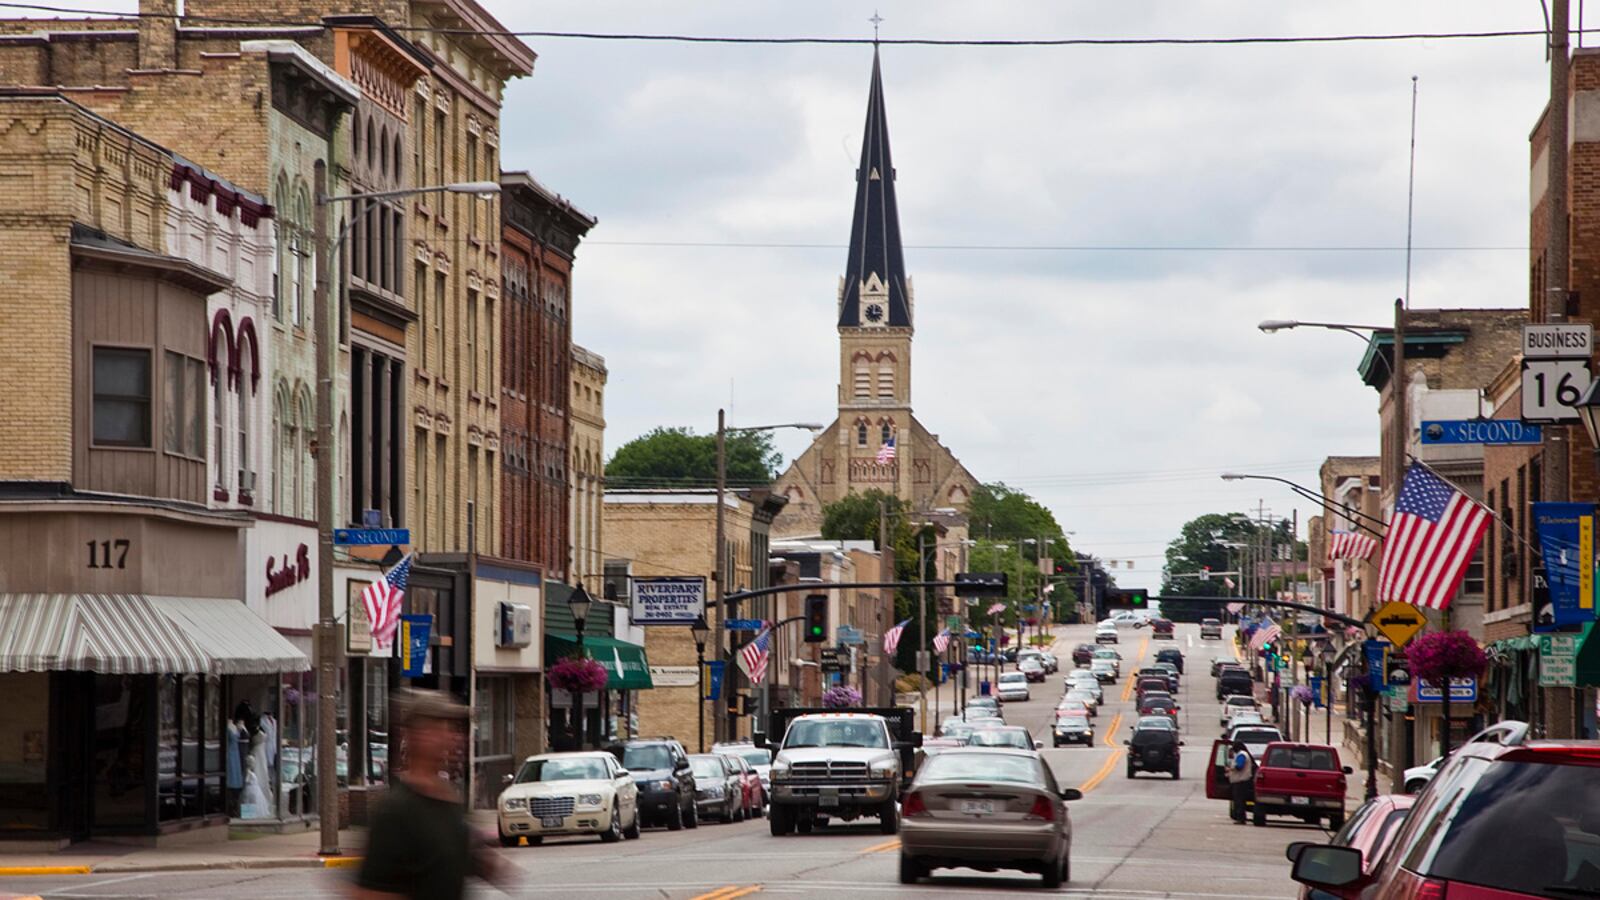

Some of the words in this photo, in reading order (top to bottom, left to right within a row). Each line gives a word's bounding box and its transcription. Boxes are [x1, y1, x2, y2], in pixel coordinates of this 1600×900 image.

[1528, 332, 1587, 348] BUSINESS
[1535, 372, 1580, 408] 16
[1459, 421, 1523, 442] SECOND
[357, 530, 397, 544] SECOND
[86, 539, 130, 569] 117
[1582, 525, 1590, 590] WELCOME
[638, 584, 702, 594] RIVERPARK
[638, 594, 698, 604] PROPERTIES
[1543, 639, 1550, 651] 2
